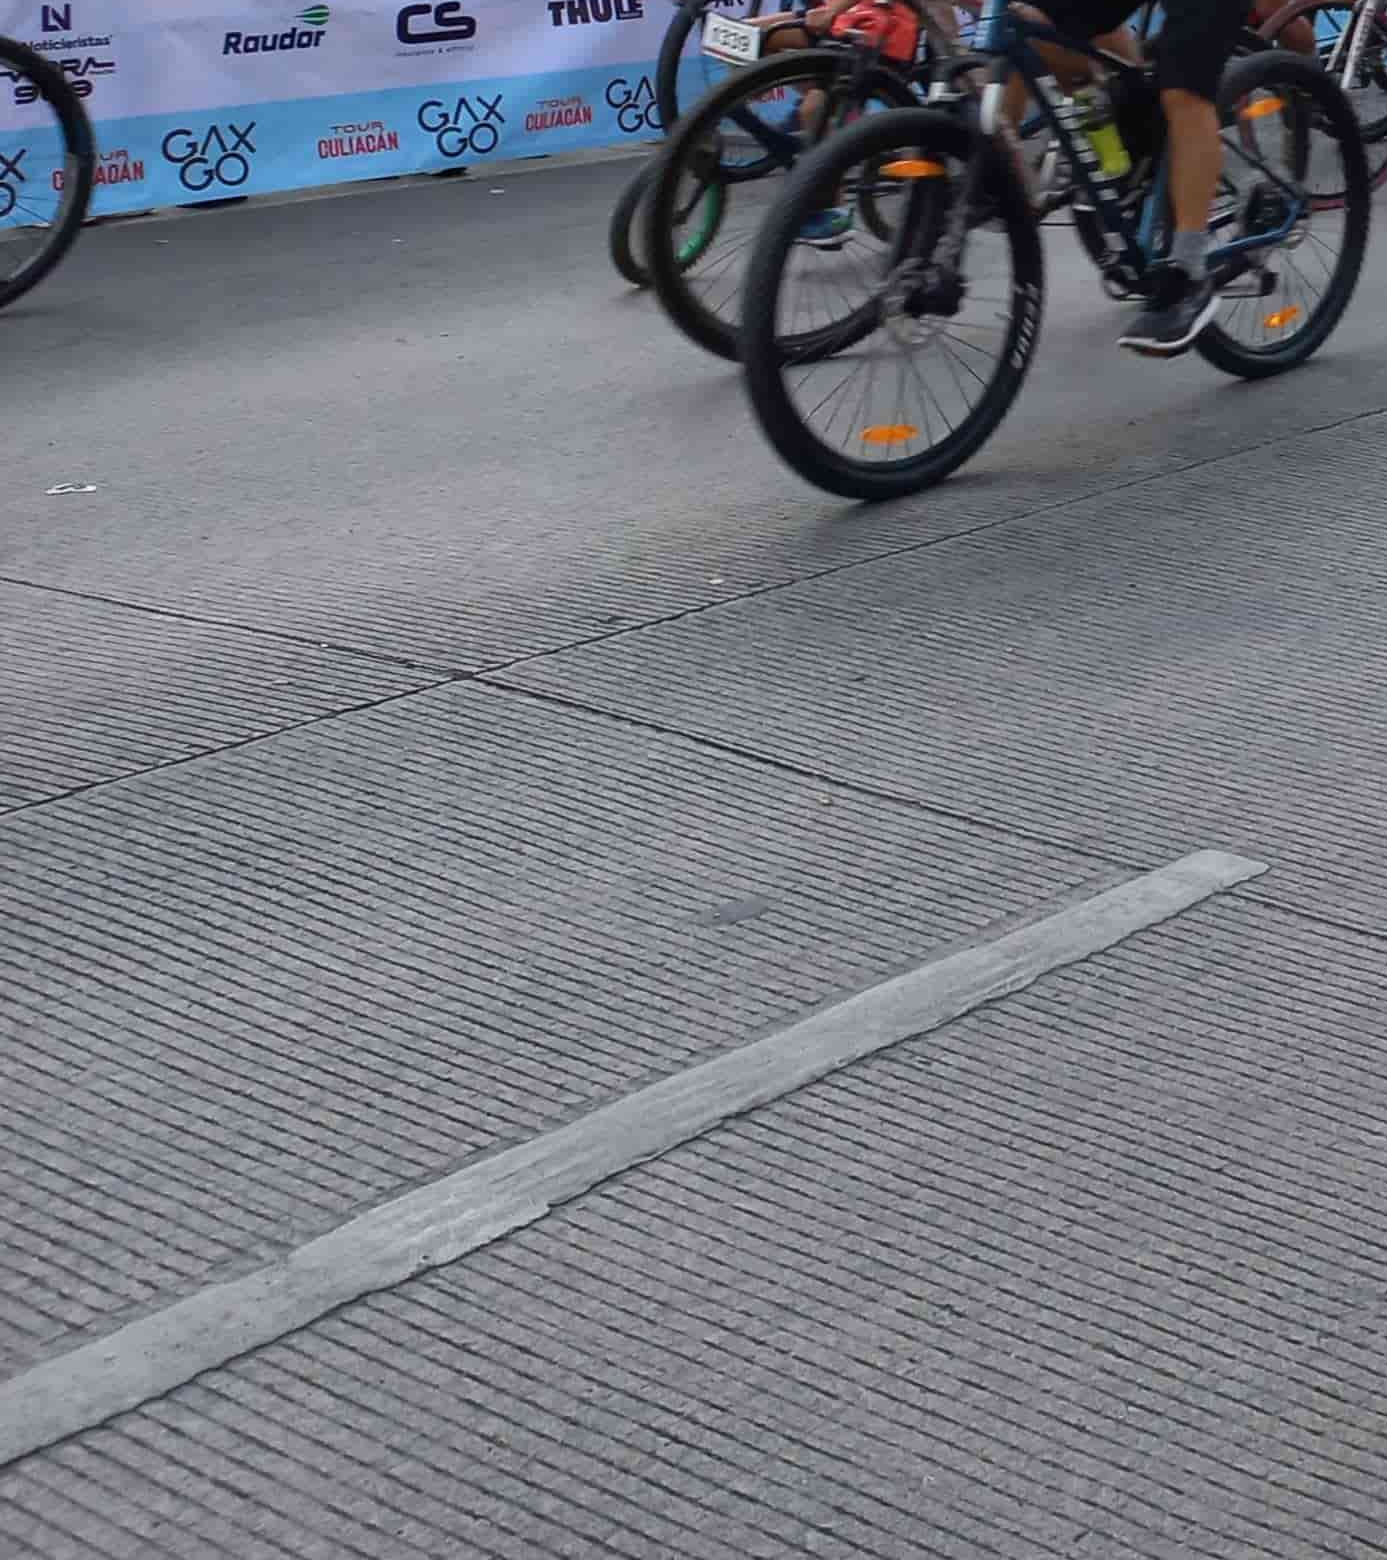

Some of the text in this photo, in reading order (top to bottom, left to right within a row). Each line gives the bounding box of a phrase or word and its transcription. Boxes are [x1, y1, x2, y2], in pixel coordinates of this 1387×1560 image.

[397, 1, 476, 44] CS
[331, 121, 384, 134] TOUR
[436, 122, 498, 158] GO
[180, 153, 250, 191] GO
